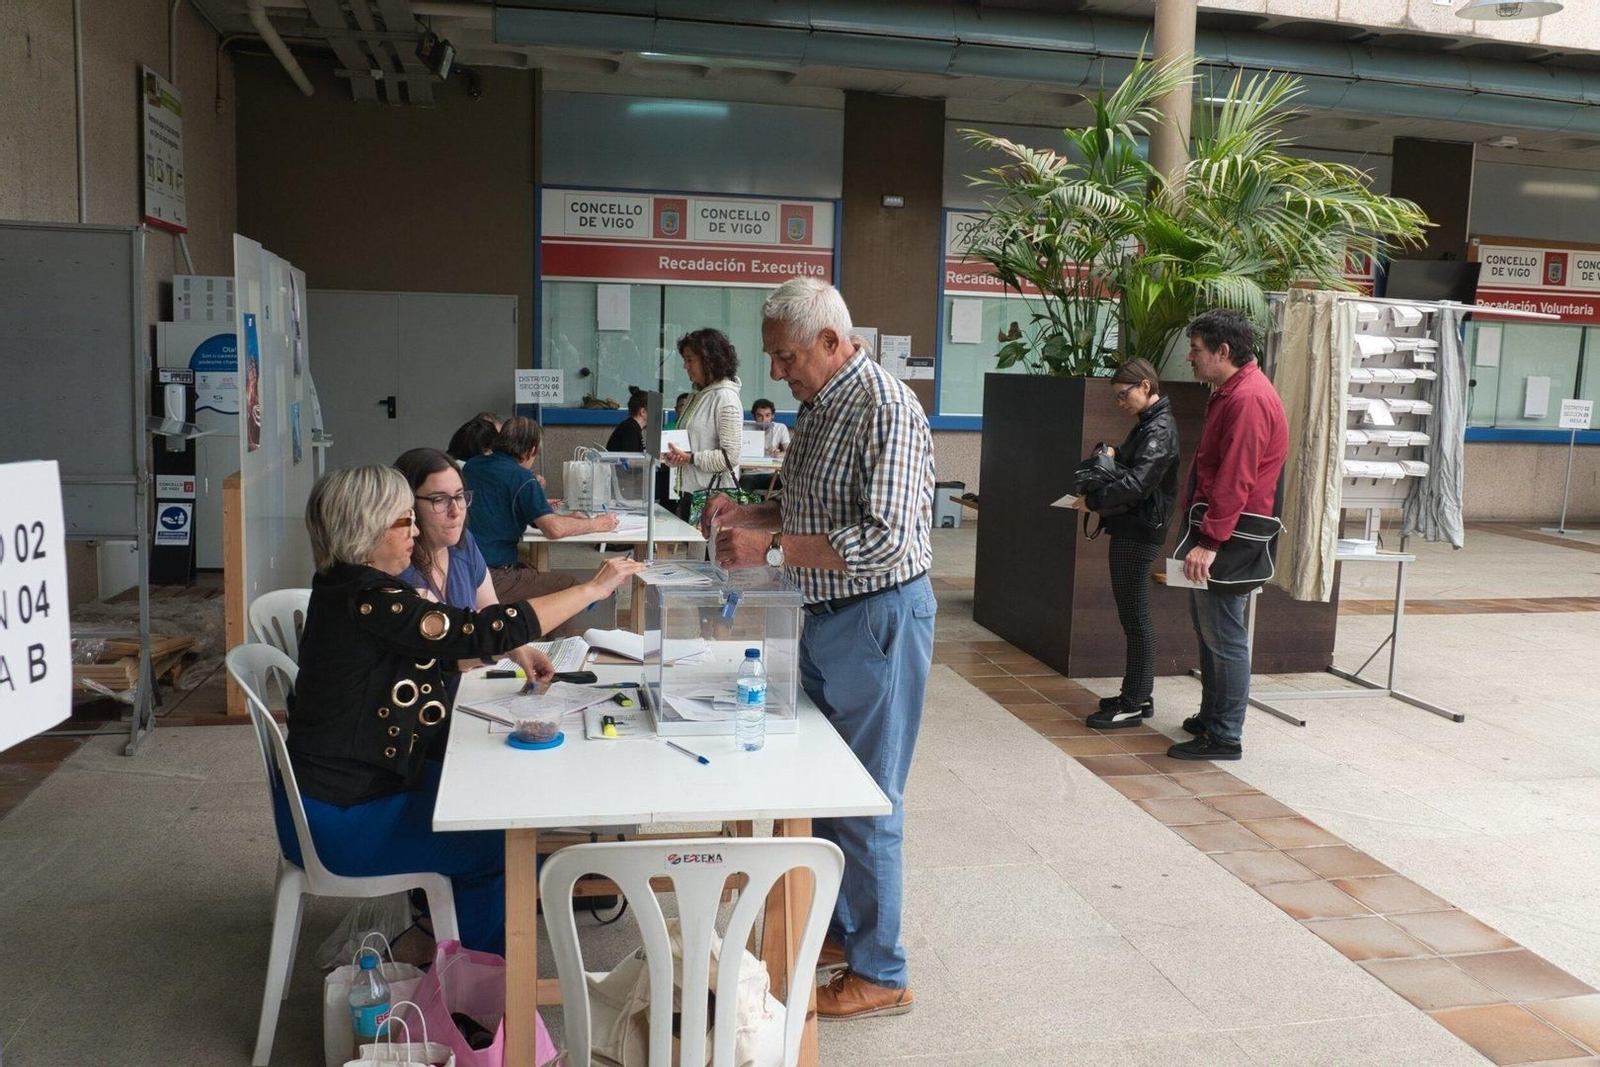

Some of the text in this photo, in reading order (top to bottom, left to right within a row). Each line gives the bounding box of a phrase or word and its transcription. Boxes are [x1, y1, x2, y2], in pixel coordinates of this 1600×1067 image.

[570, 202, 643, 215] CONCELLO
[700, 208, 771, 221] CONCELLO
[579, 216, 634, 229] DE VIGO
[709, 222, 762, 234] DE VIGO
[658, 256, 825, 275] Recadación Executiva
[1486, 255, 1537, 266] CONCELLO
[1491, 267, 1531, 277] DE VIGO
[1581, 272, 1594, 281] DE
[1540, 302, 1594, 315] Voluntaria
[14, 520, 46, 563] 02
[18, 580, 50, 624] 04
[27, 642, 47, 683] B
